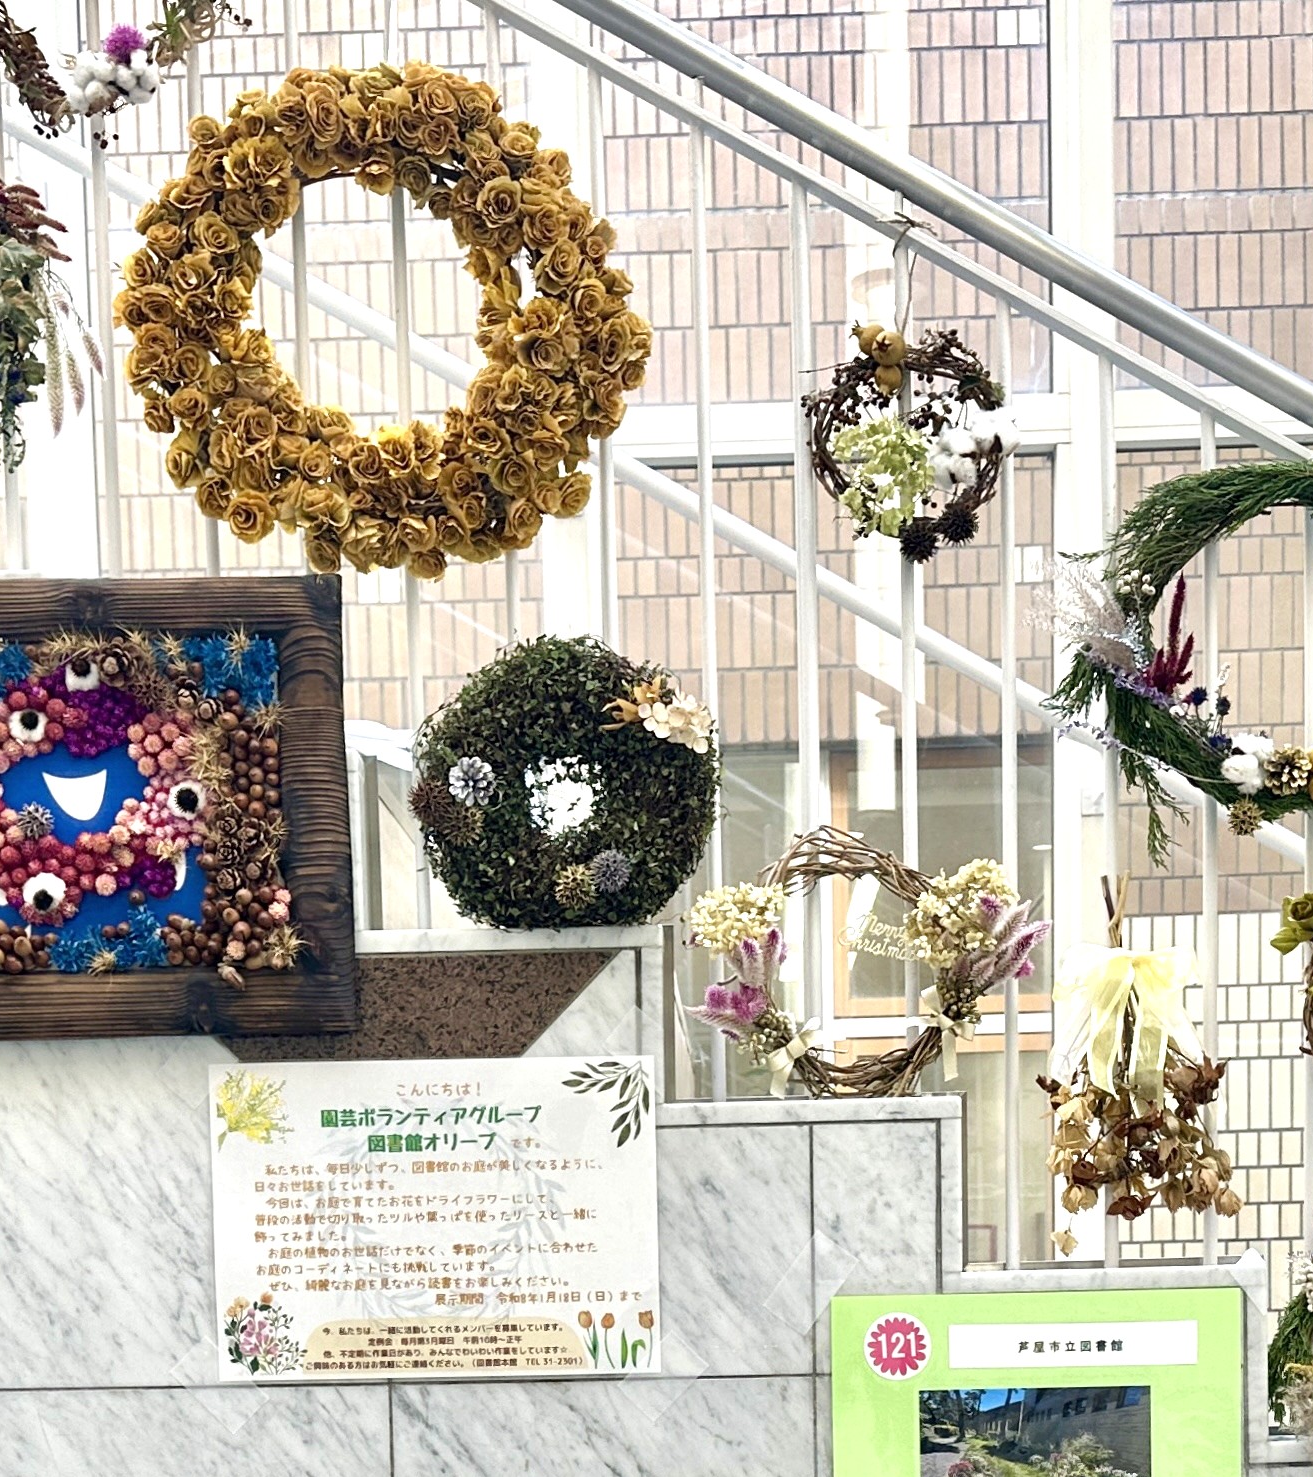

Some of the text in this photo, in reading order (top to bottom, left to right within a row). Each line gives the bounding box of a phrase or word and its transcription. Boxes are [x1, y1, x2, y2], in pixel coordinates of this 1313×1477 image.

[396, 1081, 482, 1097] こんにちは！
[321, 1105, 541, 1128] 園芸ボランティアグループ
[368, 1132, 497, 1153] 図書館オリーブ
[255, 1179, 395, 1193] 日々お世話をしています。
[254, 1231, 347, 1243] 飾ってみました。
[877, 1331, 918, 1359] 121
[1018, 1339, 1124, 1353] 芦屋市立図書館
